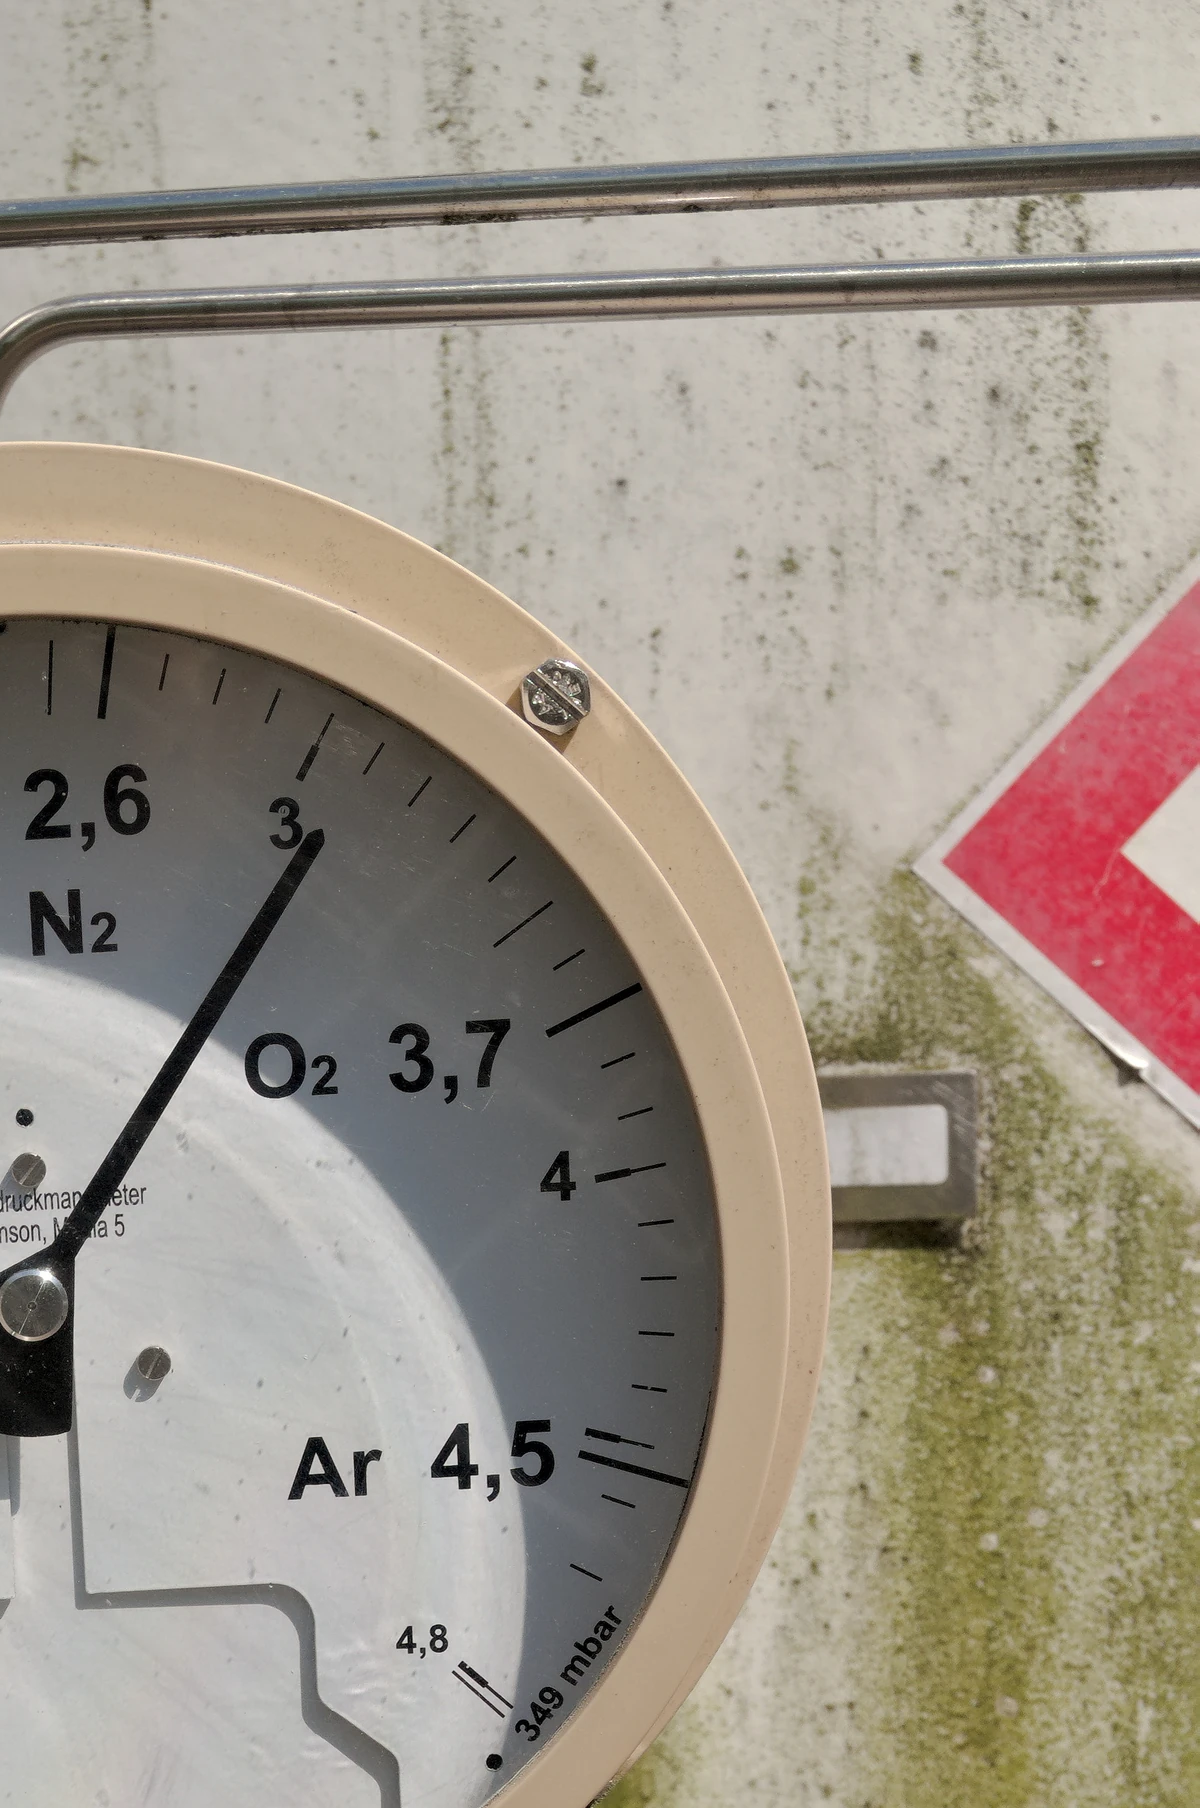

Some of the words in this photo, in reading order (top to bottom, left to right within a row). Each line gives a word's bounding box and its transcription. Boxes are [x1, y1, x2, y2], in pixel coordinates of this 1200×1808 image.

[23, 763, 151, 852] 2,6
[268, 796, 304, 850] 3
[388, 1018, 511, 1105] 3,7
[539, 1150, 577, 1202] 4
[114, 1213, 125, 1237] 5
[287, 1436, 383, 1501] Ar
[430, 1418, 560, 1502] 4,5
[395, 1623, 450, 1660] 4,8
[514, 1686, 564, 1742] 349
[559, 1604, 623, 1687] mbar
